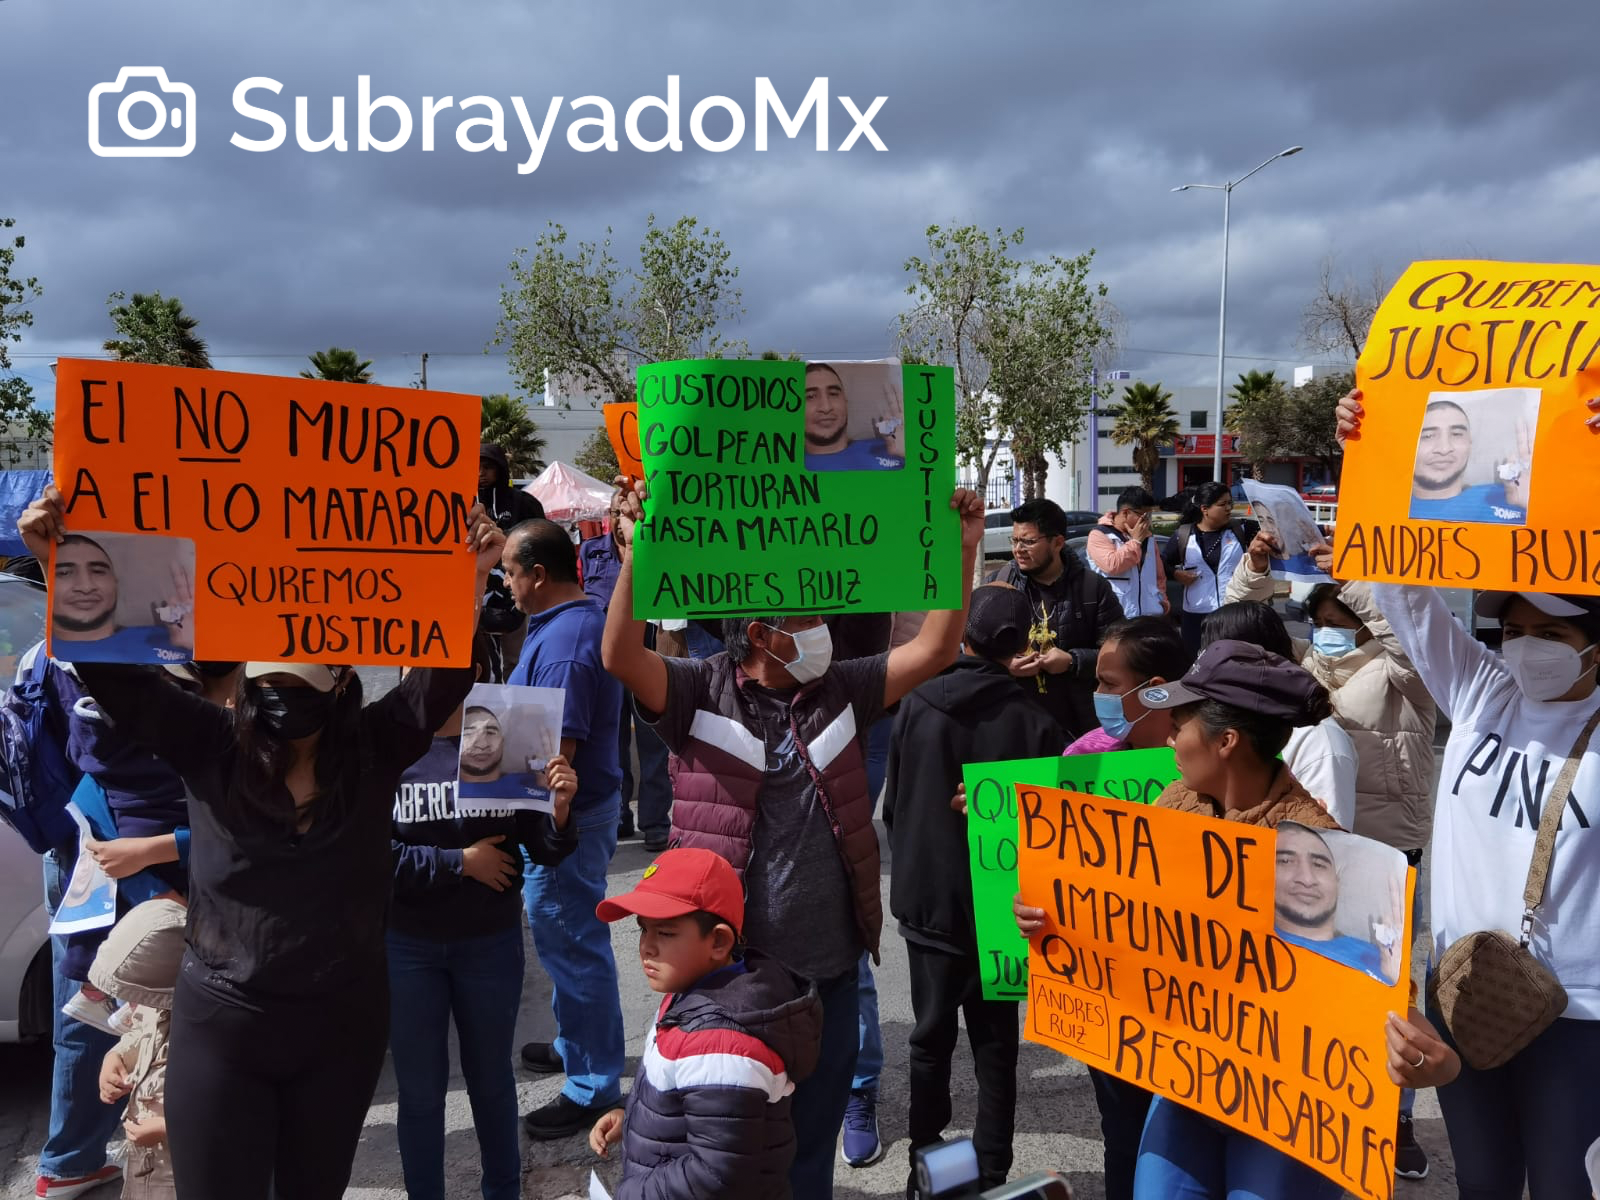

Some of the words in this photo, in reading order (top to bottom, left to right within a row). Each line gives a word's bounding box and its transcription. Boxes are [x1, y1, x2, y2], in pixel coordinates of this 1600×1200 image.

[640, 374, 802, 413] CUSTODIOS
[174, 387, 249, 454] NO
[289, 400, 460, 476] MURIO
[645, 423, 796, 465] GOLPEAN
[67, 468, 107, 519] A
[202, 479, 260, 533] LO
[284, 486, 475, 546] MATARON
[667, 470, 821, 511] TORTURAN
[917, 372, 939, 599] JUSTICIA
[639, 516, 729, 548] HASTA
[736, 512, 878, 551] MATARLO
[1337, 523, 1480, 579] ANDRES
[207, 562, 402, 606] QUREMOS
[652, 572, 785, 608] ANDRES
[799, 568, 862, 605] RUIZ
[278, 613, 448, 658] JUSTICIA
[1021, 791, 1160, 886] BASTA
[1202, 830, 1258, 912] DE
[1053, 879, 1296, 993] IMPUNIDAD
[1036, 984, 1105, 1027] ANDRES
[1040, 934, 1120, 1000] QUE
[1143, 968, 1280, 1062] PAGUEN
[1302, 1026, 1374, 1109] LOS
[1048, 1013, 1088, 1046] RUIZ
[1115, 1015, 1394, 1200] RESPONSABLES
